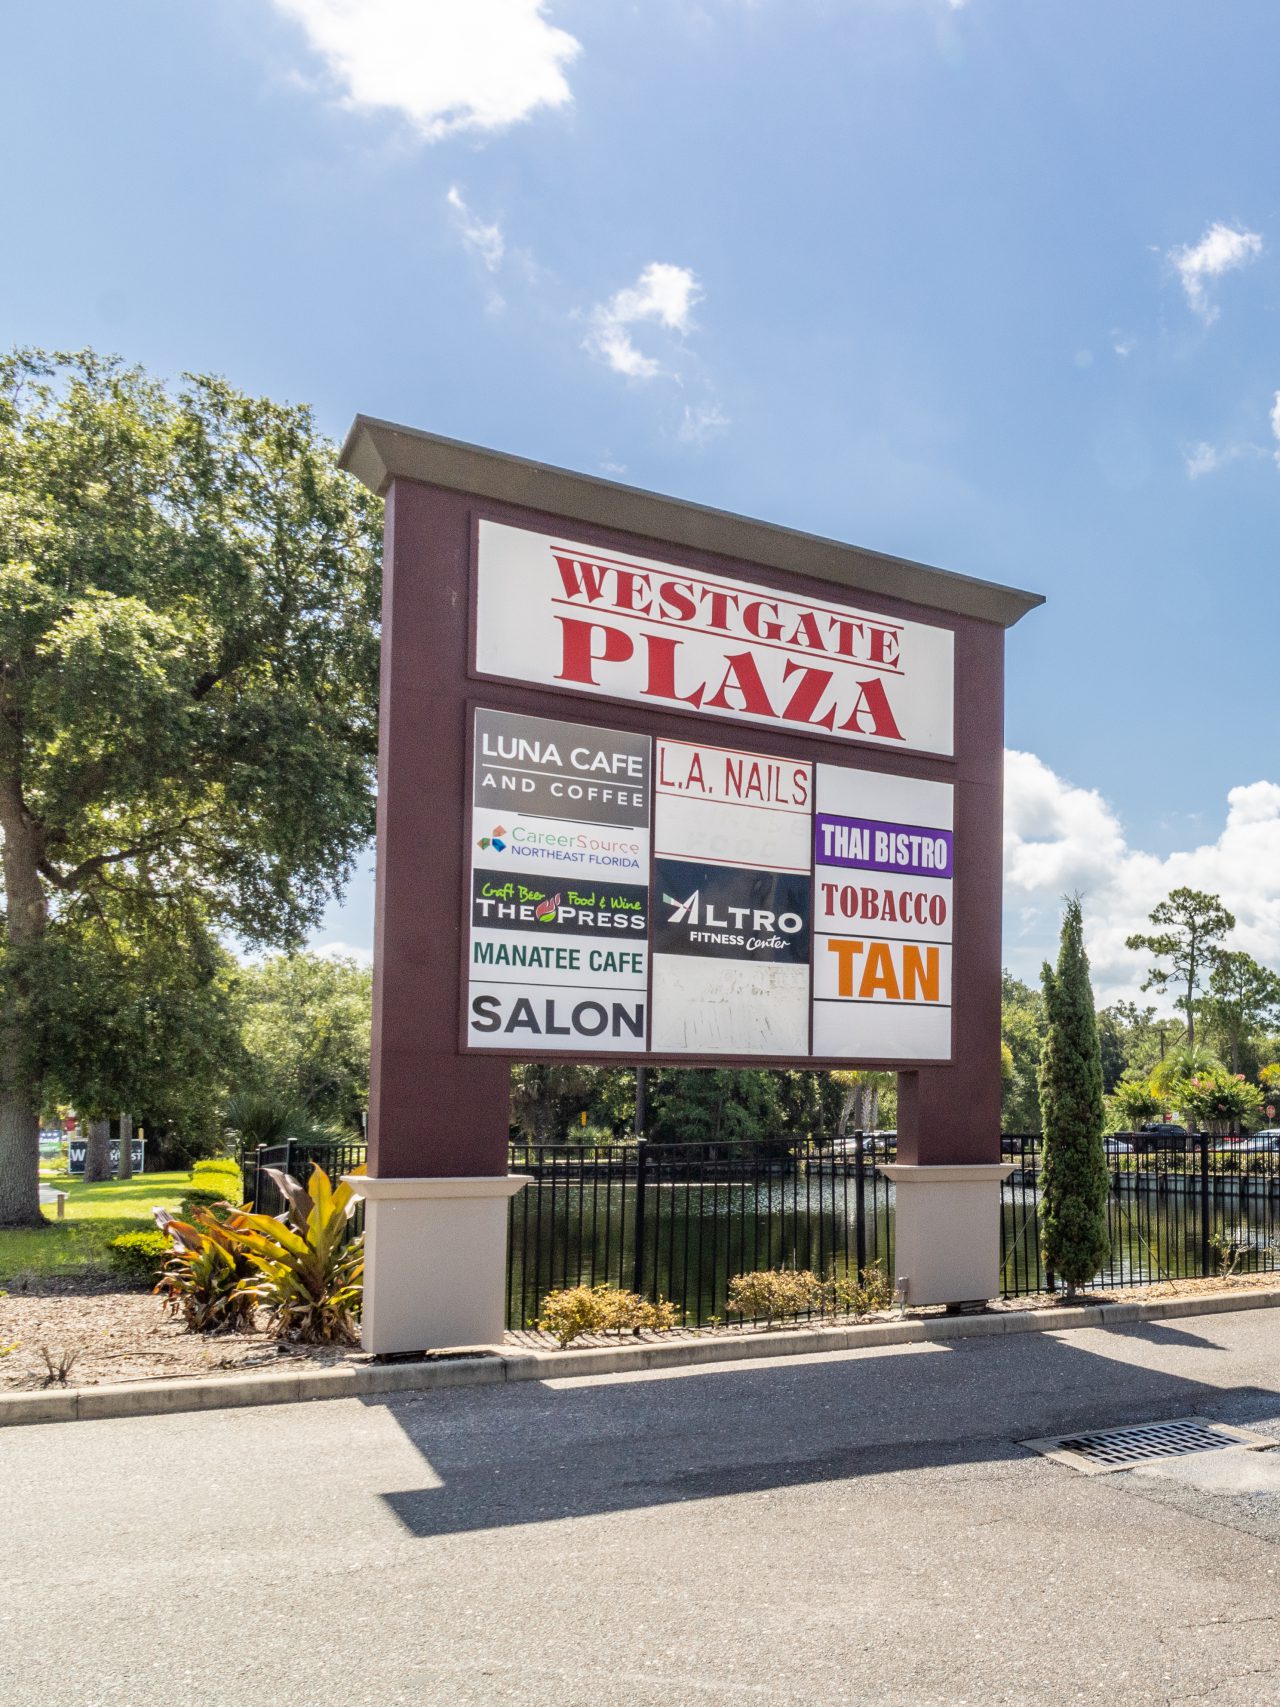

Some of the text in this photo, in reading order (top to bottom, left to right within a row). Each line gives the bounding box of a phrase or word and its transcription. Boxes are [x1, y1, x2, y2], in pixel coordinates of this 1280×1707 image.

[552, 554, 901, 669] WESTGATE
[552, 615, 907, 741] PLAZA
[481, 733, 644, 778] LUNA CAFE
[659, 746, 808, 806] L.A. NAILS
[481, 773, 644, 808] AND COFFEE
[511, 826, 640, 855] CareerSource
[511, 845, 640, 869] NORTHEAST FLORIDA
[821, 823, 870, 861] THAI
[874, 830, 948, 870] BISTRO
[475, 898, 646, 930] THE PRESS
[481, 882, 546, 903] Craft Beer
[567, 891, 642, 911] Food & Wine
[664, 889, 803, 934] ALTRO
[821, 882, 947, 926] TOBACCO
[473, 941, 644, 974] MANATEE CAFE
[689, 931, 791, 951] FITNESS Center
[827, 938, 940, 1002] TAN
[470, 995, 645, 1038] SALON
